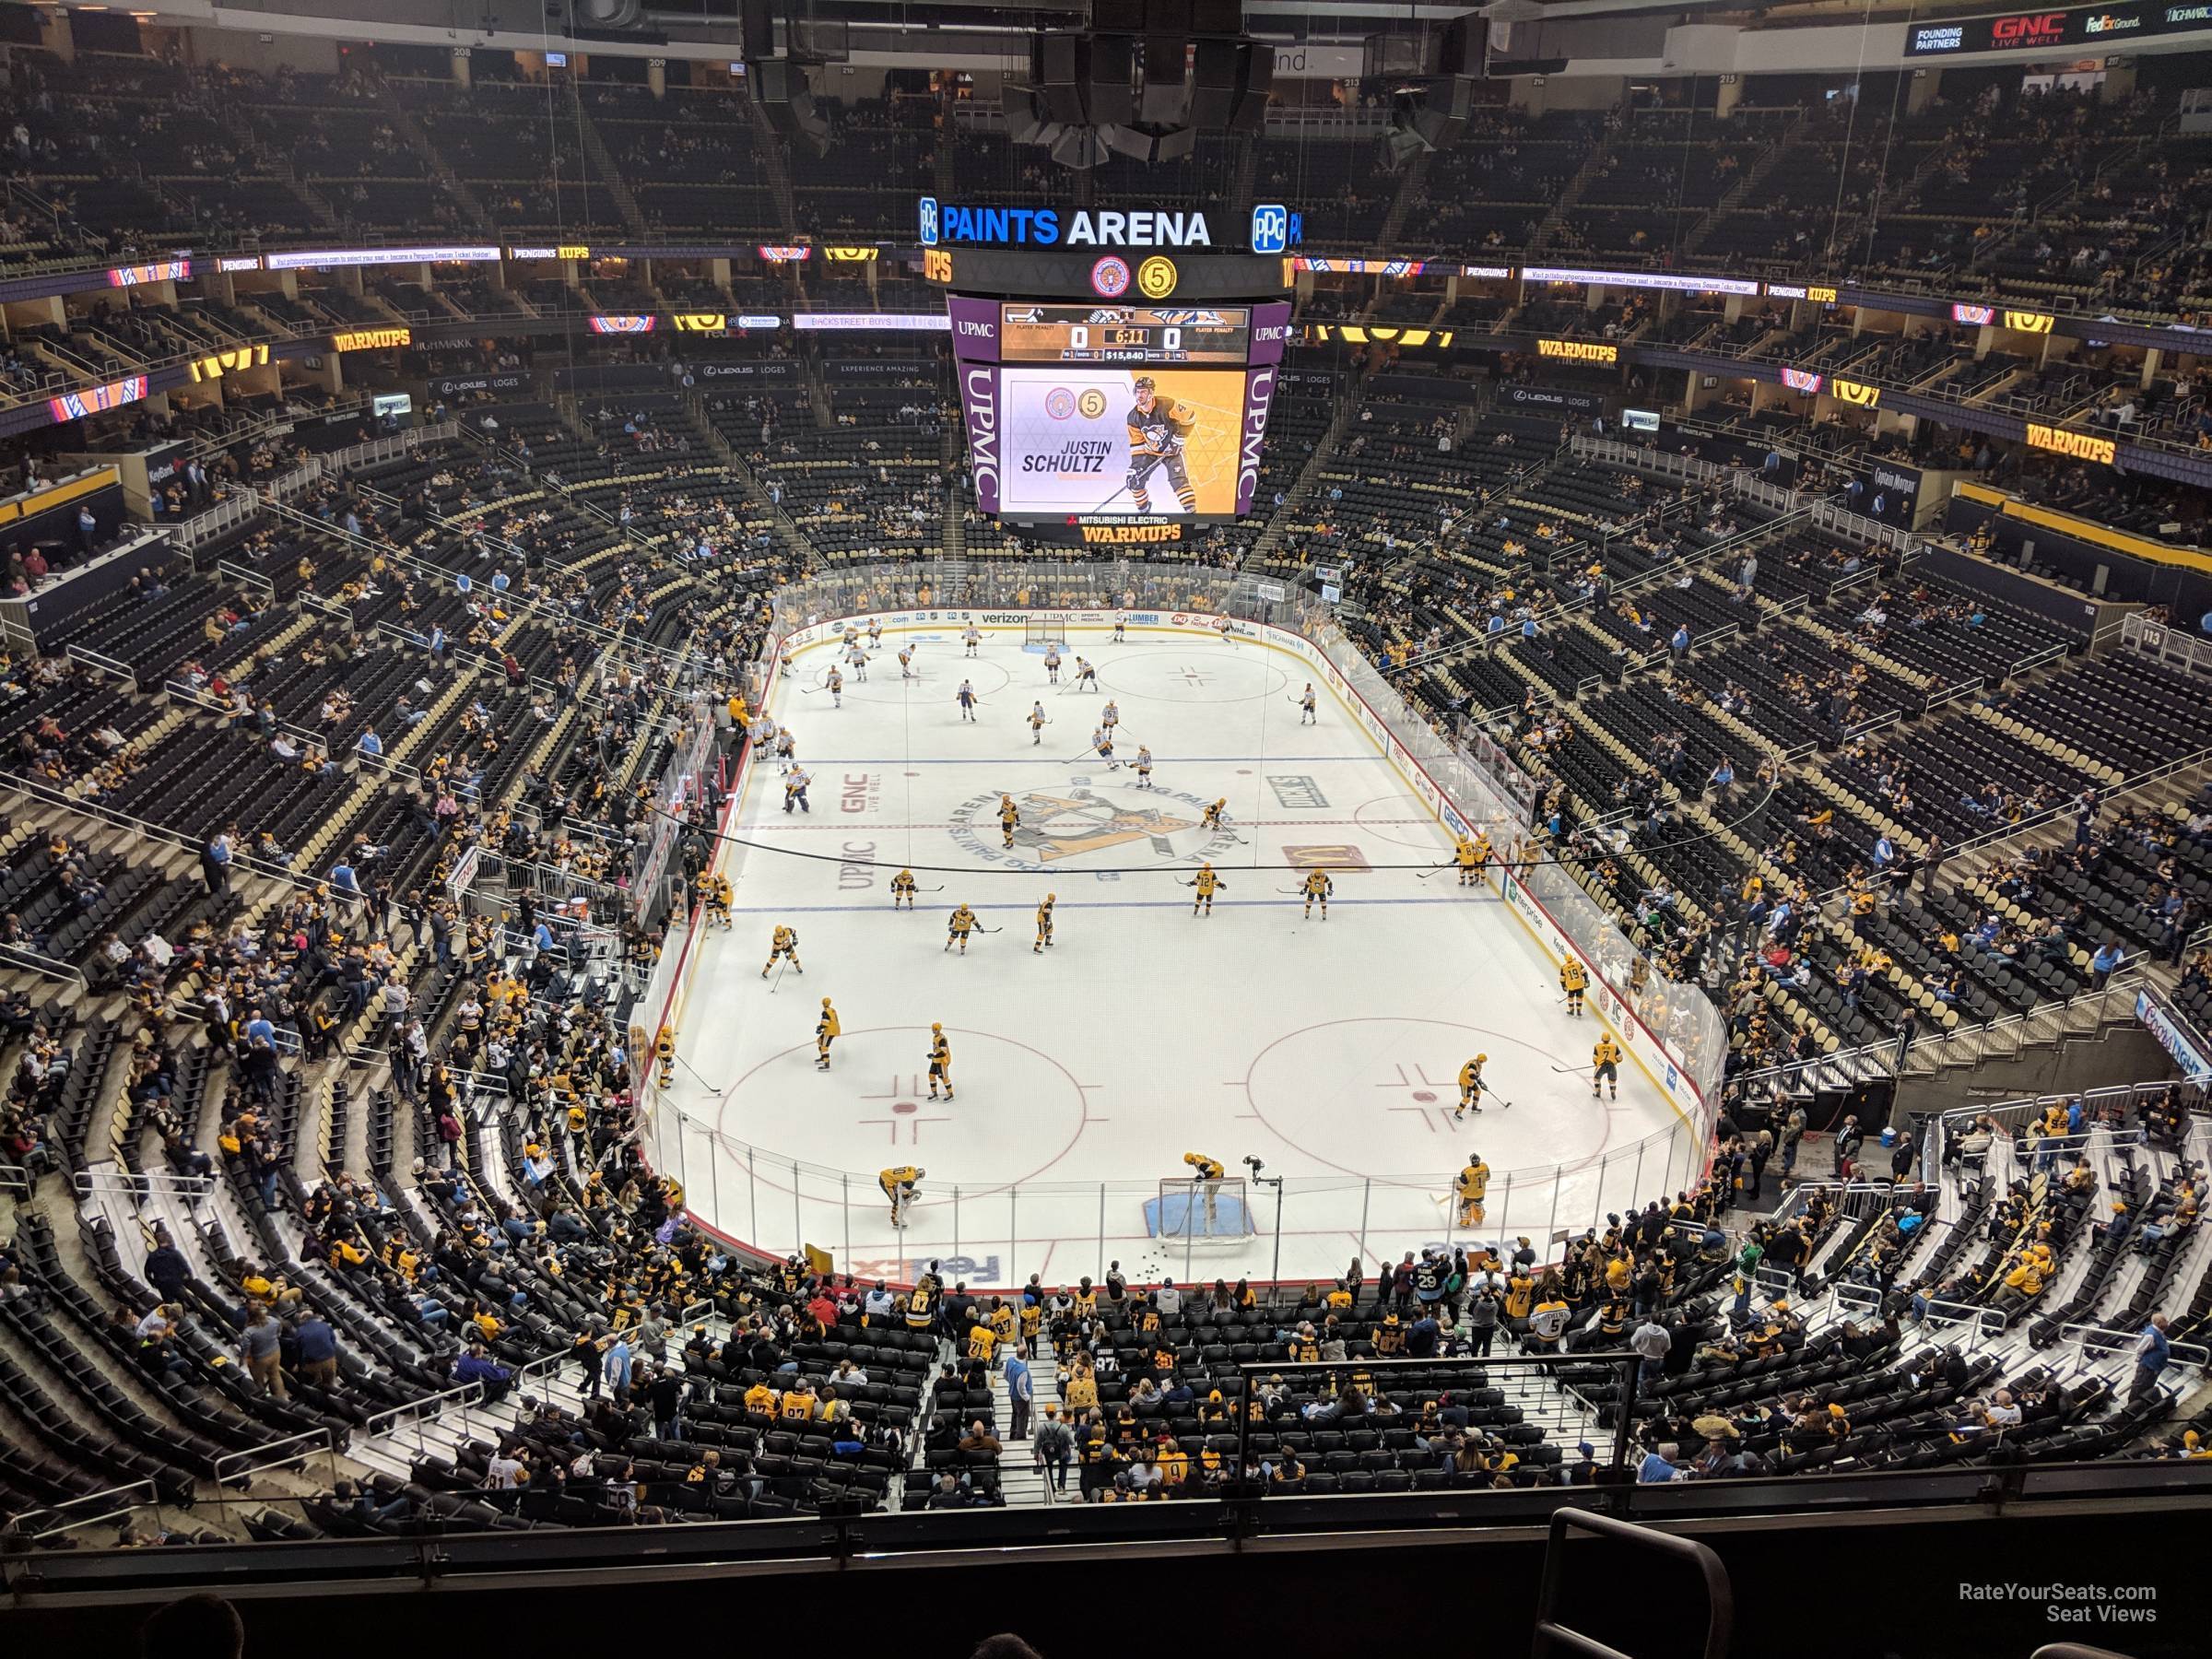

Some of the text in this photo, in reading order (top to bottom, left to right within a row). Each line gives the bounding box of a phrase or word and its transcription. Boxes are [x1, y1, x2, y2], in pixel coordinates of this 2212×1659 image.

[1993, 13, 2067, 39] GNC
[2086, 16, 2115, 33] FedEx
[1917, 27, 1962, 40] FOUNDING
[1991, 34, 2061, 47] LIVE WELL
[1916, 38, 1961, 50] PARTNERS
[453, 47, 471, 57] 208
[649, 58, 665, 67] 209
[1345, 78, 1359, 87] 213
[1720, 75, 1735, 83] 215
[922, 203, 936, 238] PPG
[944, 206, 1211, 246] PAINTS ARENA
[1255, 211, 1284, 247] PPG
[515, 249, 556, 258] PENGUINS
[223, 259, 258, 271] PENGUINS
[1467, 266, 1509, 277] PENGUINS
[1152, 266, 1164, 288] 5
[1769, 286, 1806, 299] PENGUINS
[959, 321, 994, 337] UPMC
[1255, 326, 1284, 341] UPMC
[335, 329, 411, 353] WARMUPS
[1071, 326, 1088, 348] 0
[1115, 330, 1144, 344] 6:11
[1163, 328, 1182, 349] 0
[1107, 351, 1144, 360] $15,840
[1538, 339, 1618, 361] WARMUPS
[718, 367, 754, 375] LEXUS
[454, 378, 518, 390] LEXUS LOGES
[1087, 395, 1098, 412] 5
[1528, 394, 1591, 406] LEXUS LOGES
[968, 369, 999, 499] UPMC
[1238, 370, 1273, 500] UPMC
[1061, 441, 1112, 455] JUSTIN
[2028, 424, 2116, 465] WARMUPS
[1627, 450, 1637, 459] 110
[1022, 454, 1105, 473] SCHULTZ
[149, 463, 174, 483] KeyBank
[1875, 466, 1893, 488] Captain
[1892, 474, 1916, 494] Morgan
[1078, 515, 1168, 524] MITSUBISHI ELECTRIC
[1082, 524, 1182, 545] WARMUPS
[982, 613, 1029, 624] verizon
[1044, 613, 1077, 622] UPMC
[2085, 606, 2095, 616] 112
[2144, 629, 2160, 645] 113
[841, 773, 868, 813] GNC
[869, 774, 881, 813] LIVE WELL
[949, 790, 1006, 862] PAINTS ARENA
[1444, 805, 1470, 841] GEICO
[1466, 847, 1471, 856] 8
[457, 858, 475, 885] GNC
[839, 841, 876, 890] UPMC
[1201, 877, 1209, 888] 12
[1511, 887, 1543, 929] enterprise
[1569, 969, 1579, 980] 19
[1604, 1051, 1609, 1060] 7
[2172, 1040, 2201, 1076] LIGHT
[1477, 1177, 1482, 1189] 1
[1349, 1277, 1362, 1287] 87
[1418, 1276, 1437, 1288] 29
[912, 1295, 929, 1312] 87
[1519, 1292, 1526, 1305] 7
[613, 1316, 629, 1332] 87
[994, 1319, 1012, 1335] 87
[1143, 1318, 1159, 1331] 87
[1551, 1320, 1559, 1333] 5
[970, 1339, 983, 1354] 71
